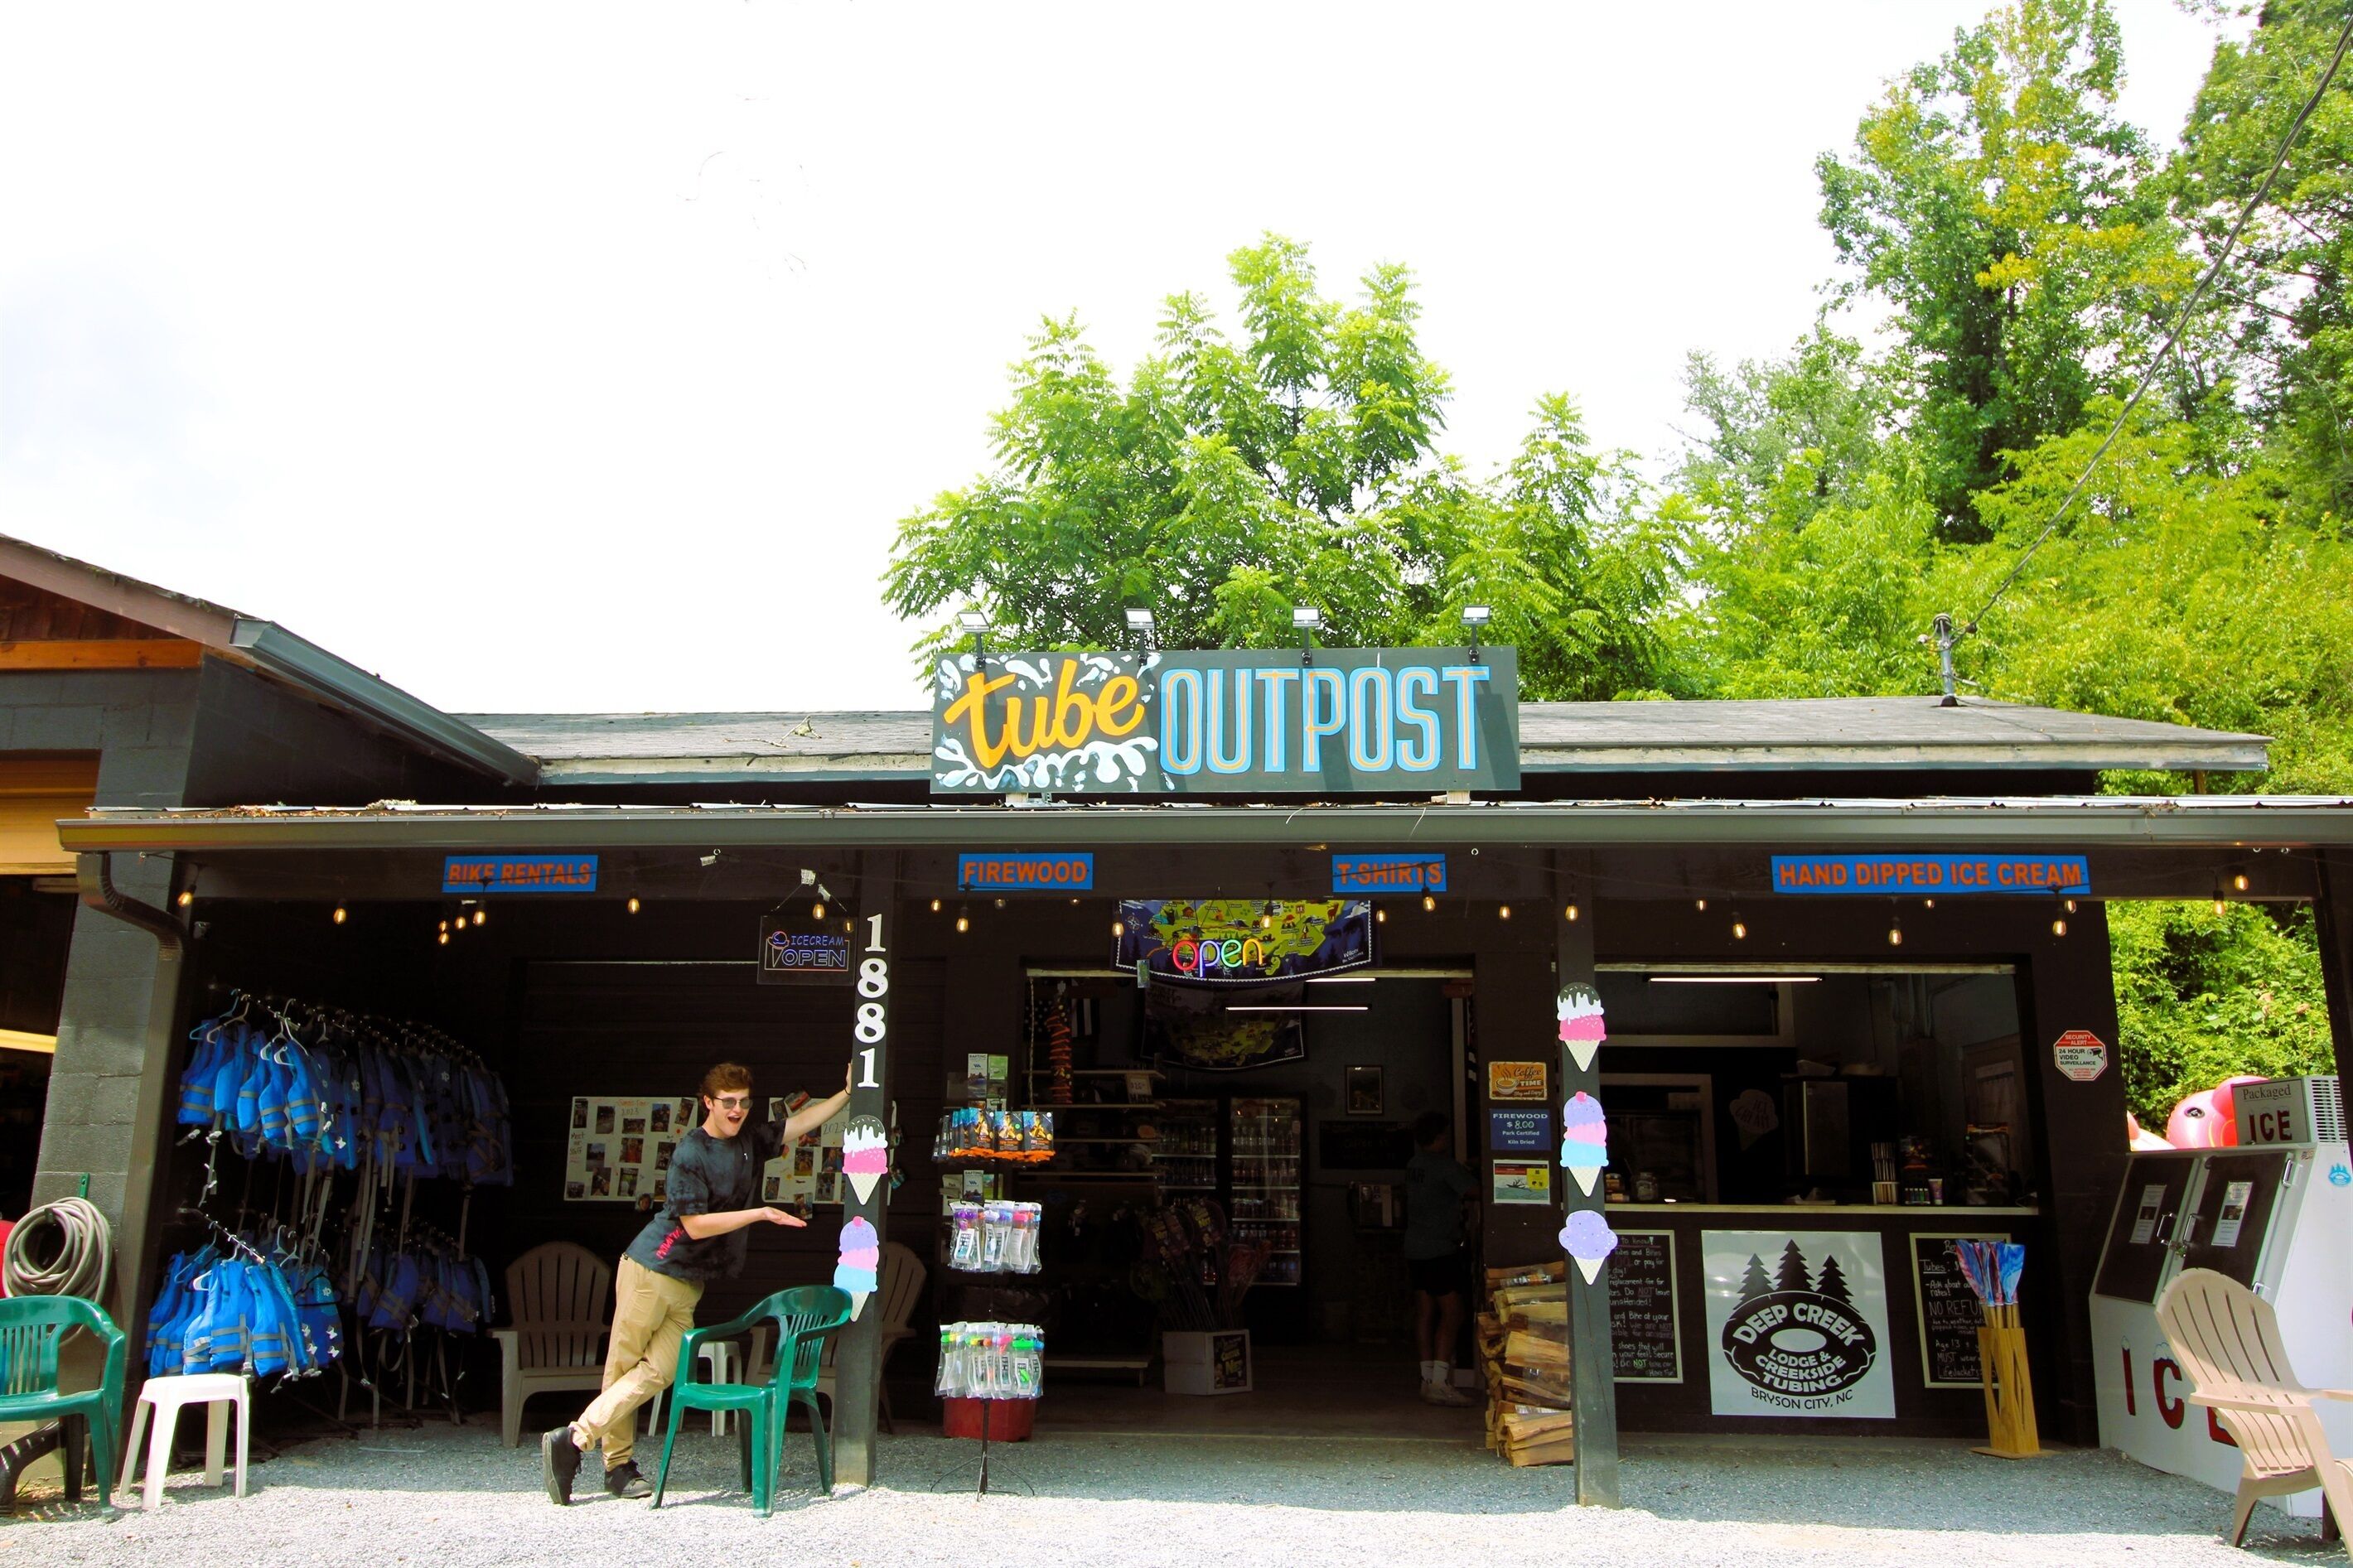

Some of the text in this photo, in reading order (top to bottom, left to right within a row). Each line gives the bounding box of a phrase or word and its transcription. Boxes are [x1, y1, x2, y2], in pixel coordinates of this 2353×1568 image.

[944, 659, 1490, 774] tube OUTPOST
[447, 862, 592, 885] BIKE RENTALS
[963, 861, 1088, 884] FIREWOOD
[1336, 861, 1443, 885] T-SHIRTS
[1779, 862, 2082, 886] HAND DIPPED ICE CREAM
[791, 935, 844, 946] ICECREAM
[781, 949, 846, 967] OPEN
[1172, 938, 1263, 978] open
[2242, 1084, 2292, 1100] Packaged
[1514, 1120, 1535, 1129] 8.00
[2249, 1107, 2293, 1142] ICE
[1929, 1300, 1944, 1316] NO
[1732, 1302, 1866, 1347] DEEP CREEK
[1632, 1358, 1647, 1369] NOT
[1755, 1354, 1847, 1381] CREEKSIDE
[1768, 1348, 1832, 1367] LODGE &
[1762, 1372, 1843, 1392] TUBING
[1751, 1387, 1854, 1410] BRYSON CITY, NC
